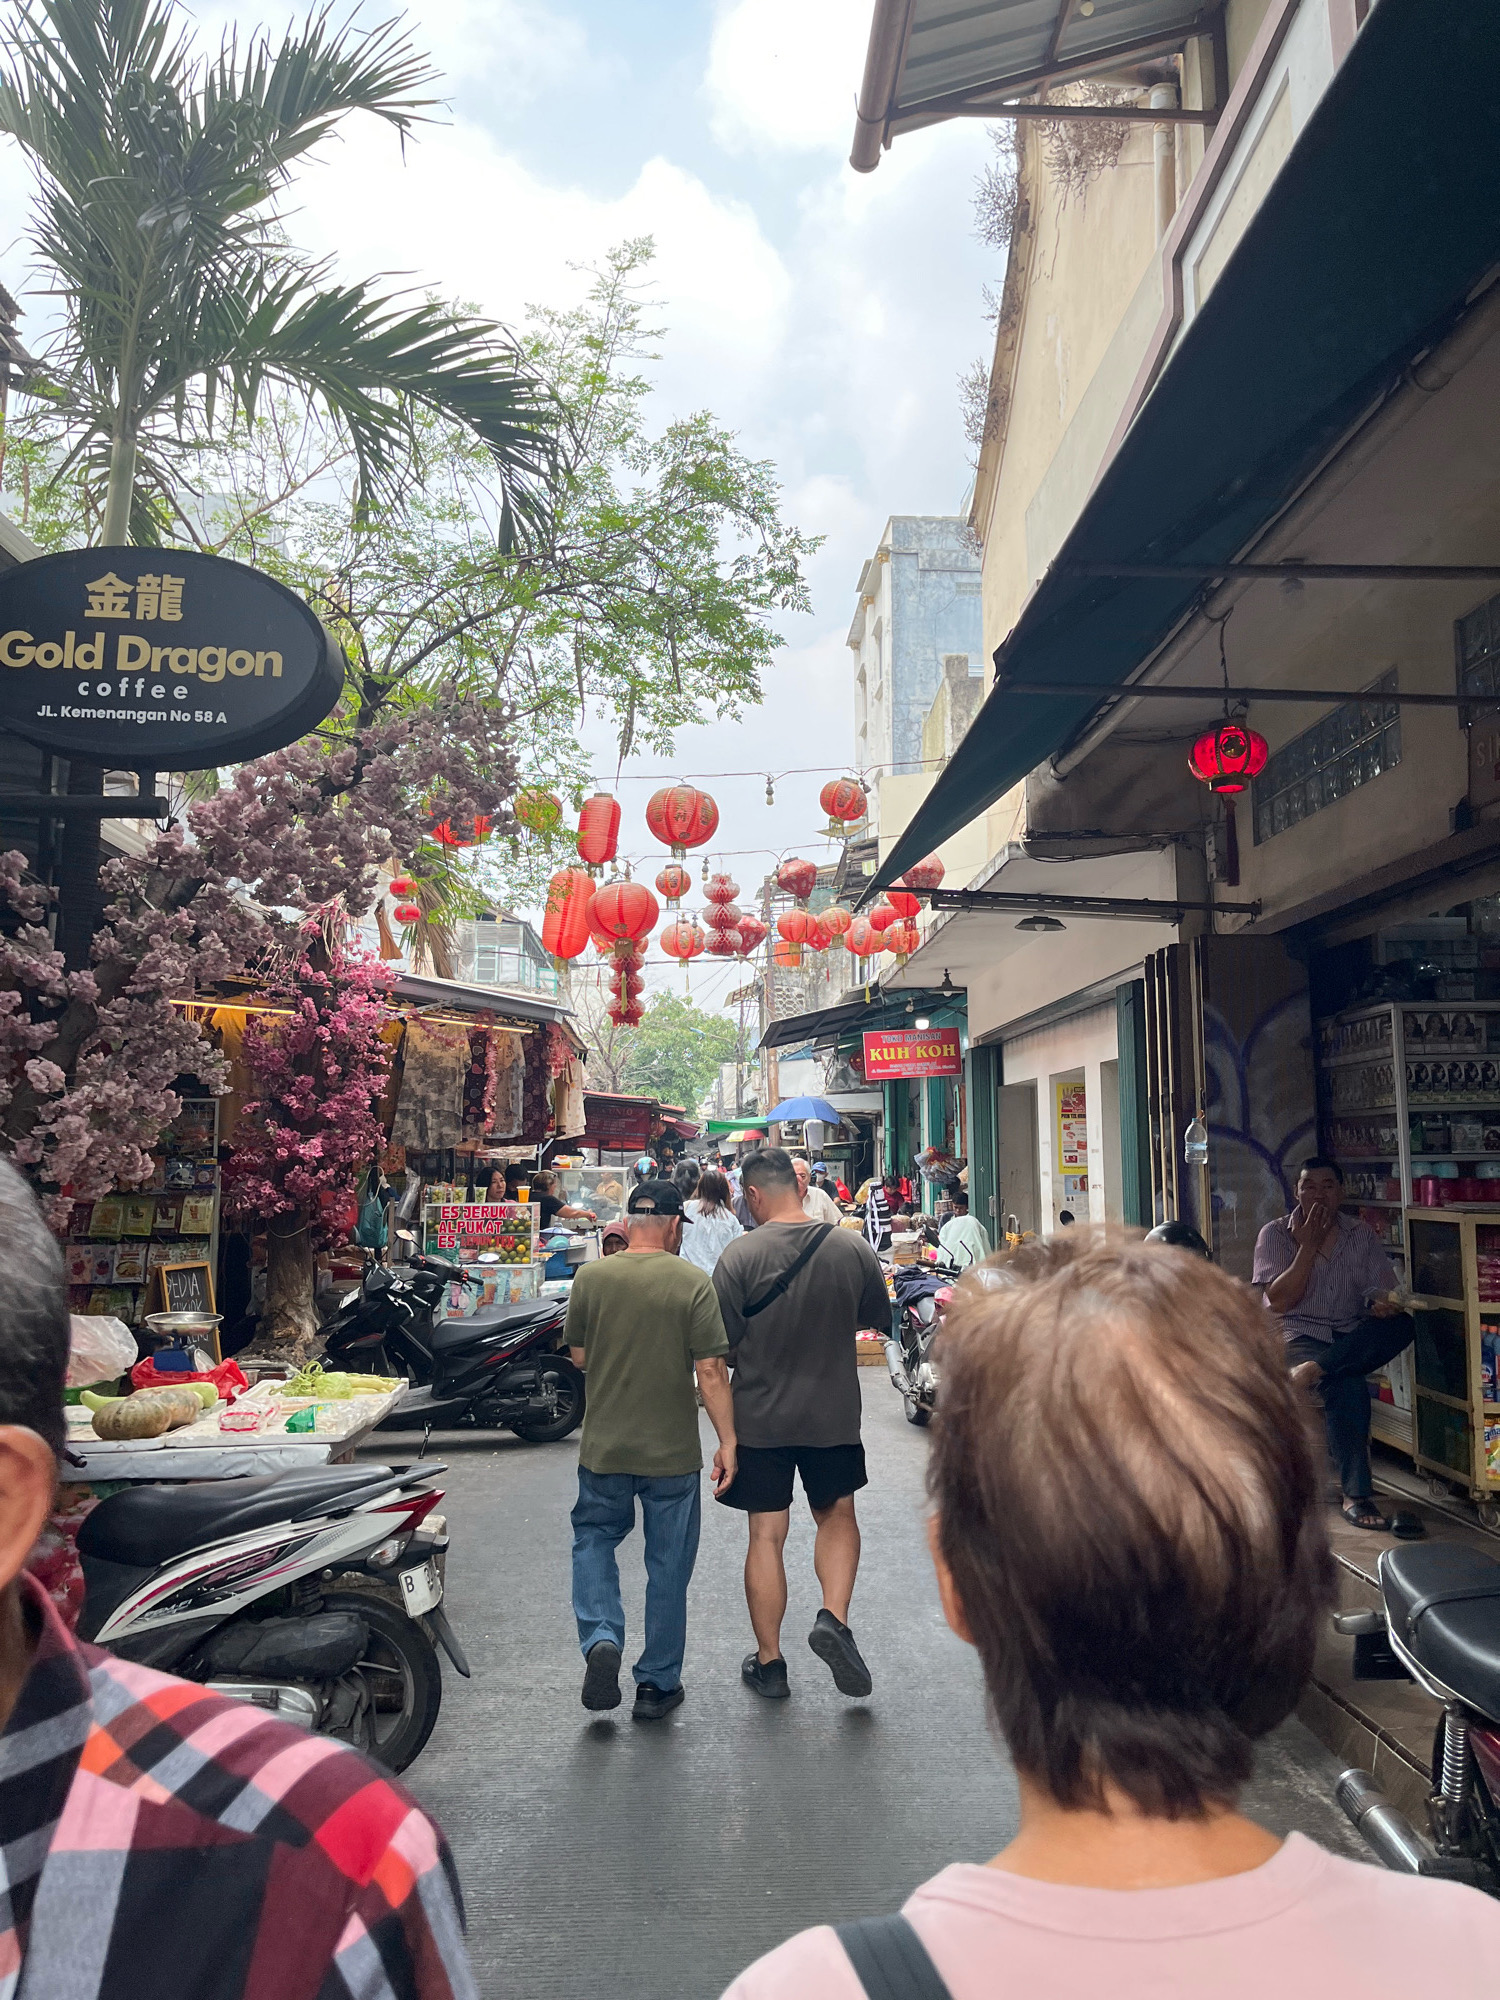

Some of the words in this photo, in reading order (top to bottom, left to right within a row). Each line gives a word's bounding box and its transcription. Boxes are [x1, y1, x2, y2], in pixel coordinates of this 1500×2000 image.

[84, 571, 186, 622] 金龍
[0, 630, 106, 670] Gold
[116, 634, 283, 683] Dragon
[77, 677, 189, 700] coffee
[37, 705, 58, 718] JL.
[60, 706, 167, 724] Kemenangan
[170, 709, 191, 722] No
[194, 710, 213, 723] 58
[215, 711, 227, 724] A
[881, 1034, 903, 1044] TOKO
[904, 1032, 941, 1042] MANISAN
[869, 1046, 910, 1062] KUH
[916, 1043, 956, 1059] KOH
[441, 1206, 459, 1220] ES
[463, 1205, 508, 1220] JERUK
[438, 1220, 503, 1235] ALPUKAT
[437, 1235, 456, 1249] ES
[461, 1235, 492, 1247] LEMON
[404, 1575, 415, 1593] B
